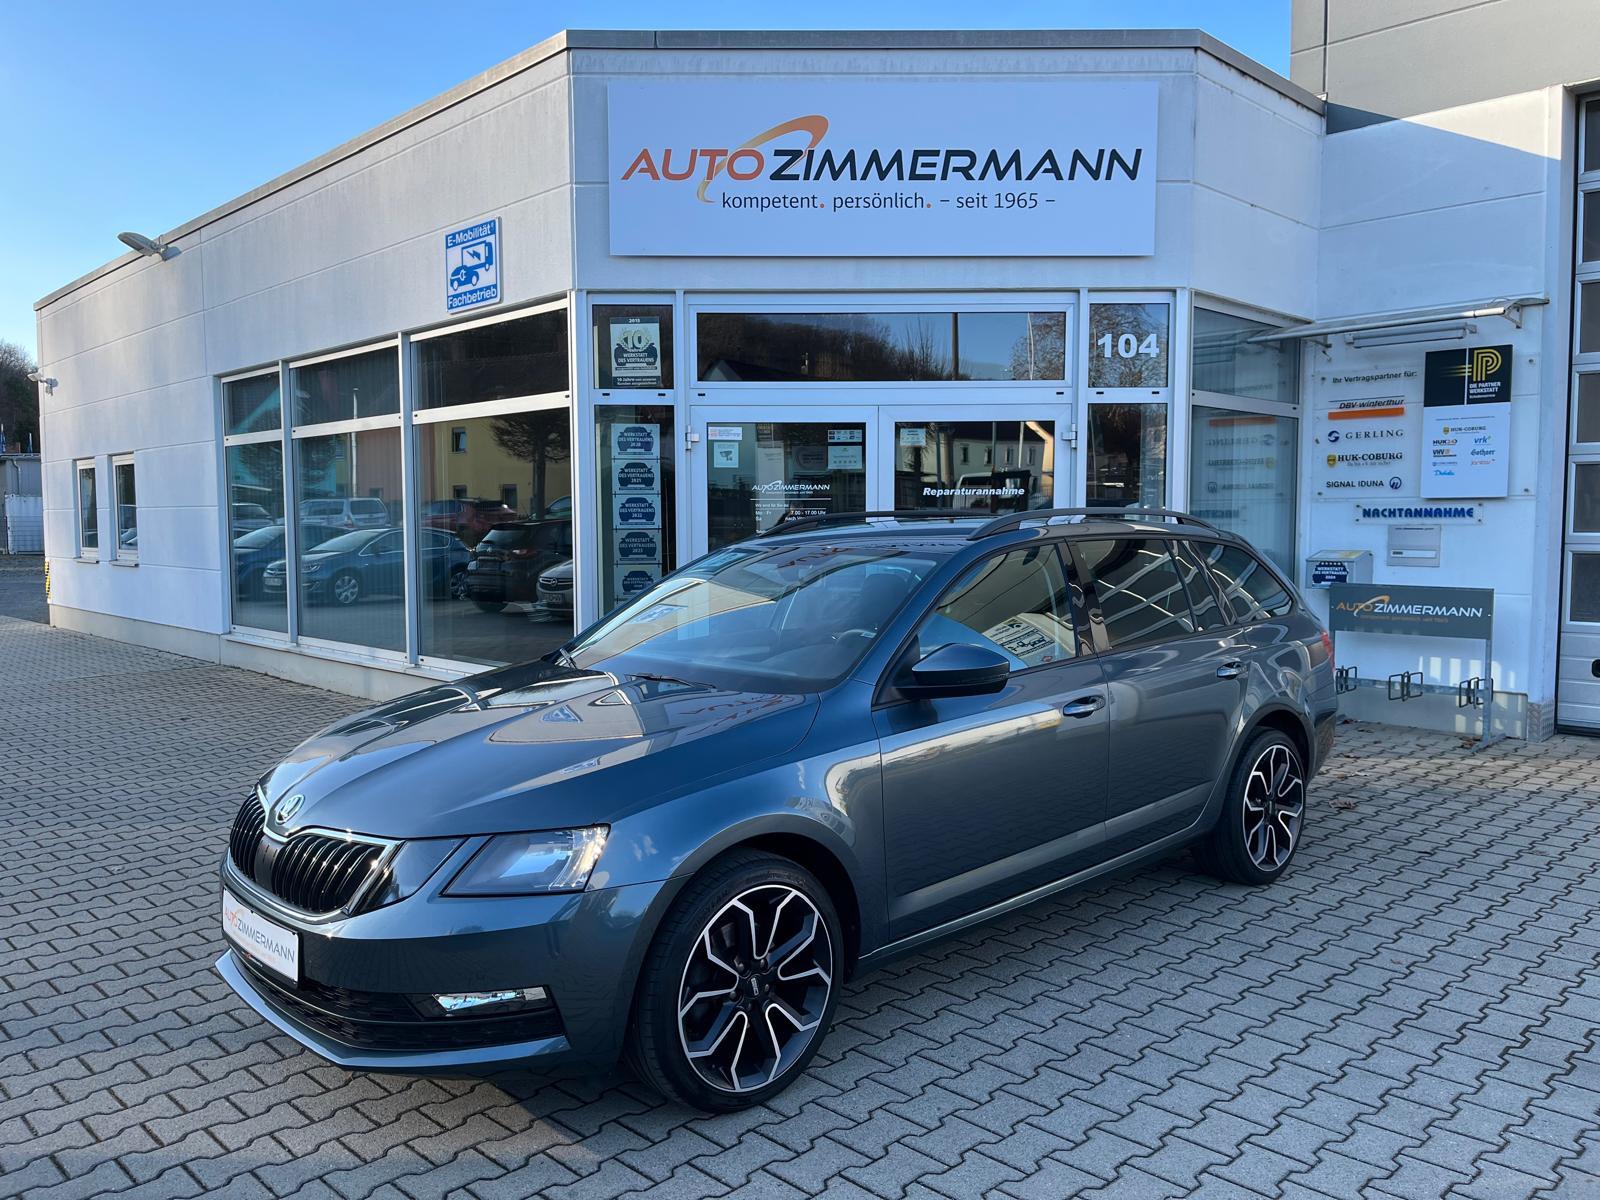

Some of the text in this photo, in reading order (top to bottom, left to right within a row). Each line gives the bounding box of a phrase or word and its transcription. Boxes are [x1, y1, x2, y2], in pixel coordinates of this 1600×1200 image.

[722, 192, 825, 212] kompetent.
[833, 192, 932, 212] persönlich.
[956, 192, 988, 209] seit
[994, 192, 1038, 209] 1965
[447, 287, 497, 308] Fachbetrieb
[1097, 333, 1160, 358] 104
[1344, 372, 1402, 382] Vertragspartner
[1345, 429, 1404, 440] GERLING
[1337, 452, 1403, 462] HUK-COBURG
[1326, 480, 1385, 488] SIGNAL IDUNA
[923, 487, 1025, 498] Reparaturannahme
[1362, 507, 1474, 518] NACHTANNAHME
